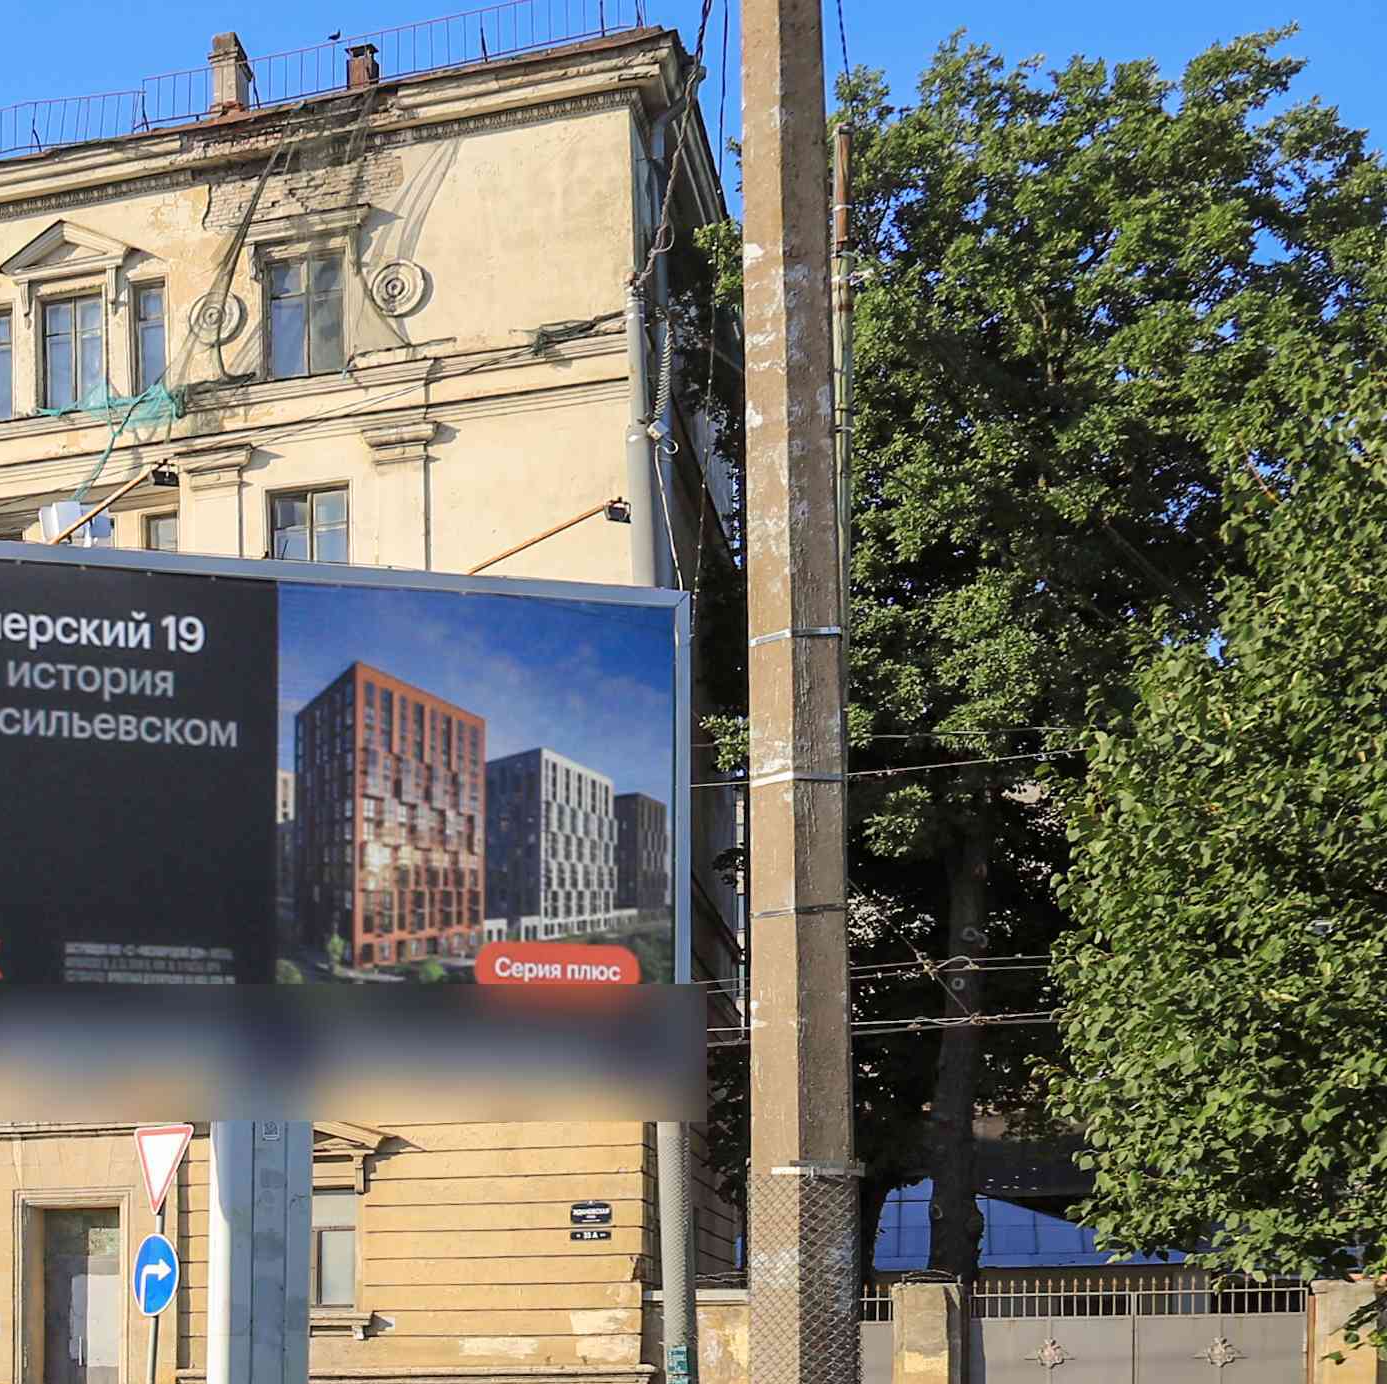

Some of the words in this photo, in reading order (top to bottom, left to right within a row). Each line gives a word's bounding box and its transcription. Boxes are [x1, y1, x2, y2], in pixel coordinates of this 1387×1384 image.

[161, 614, 206, 653] 19
[7, 660, 175, 701] история
[494, 956, 562, 982] Серия
[567, 963, 621, 981] плюс
